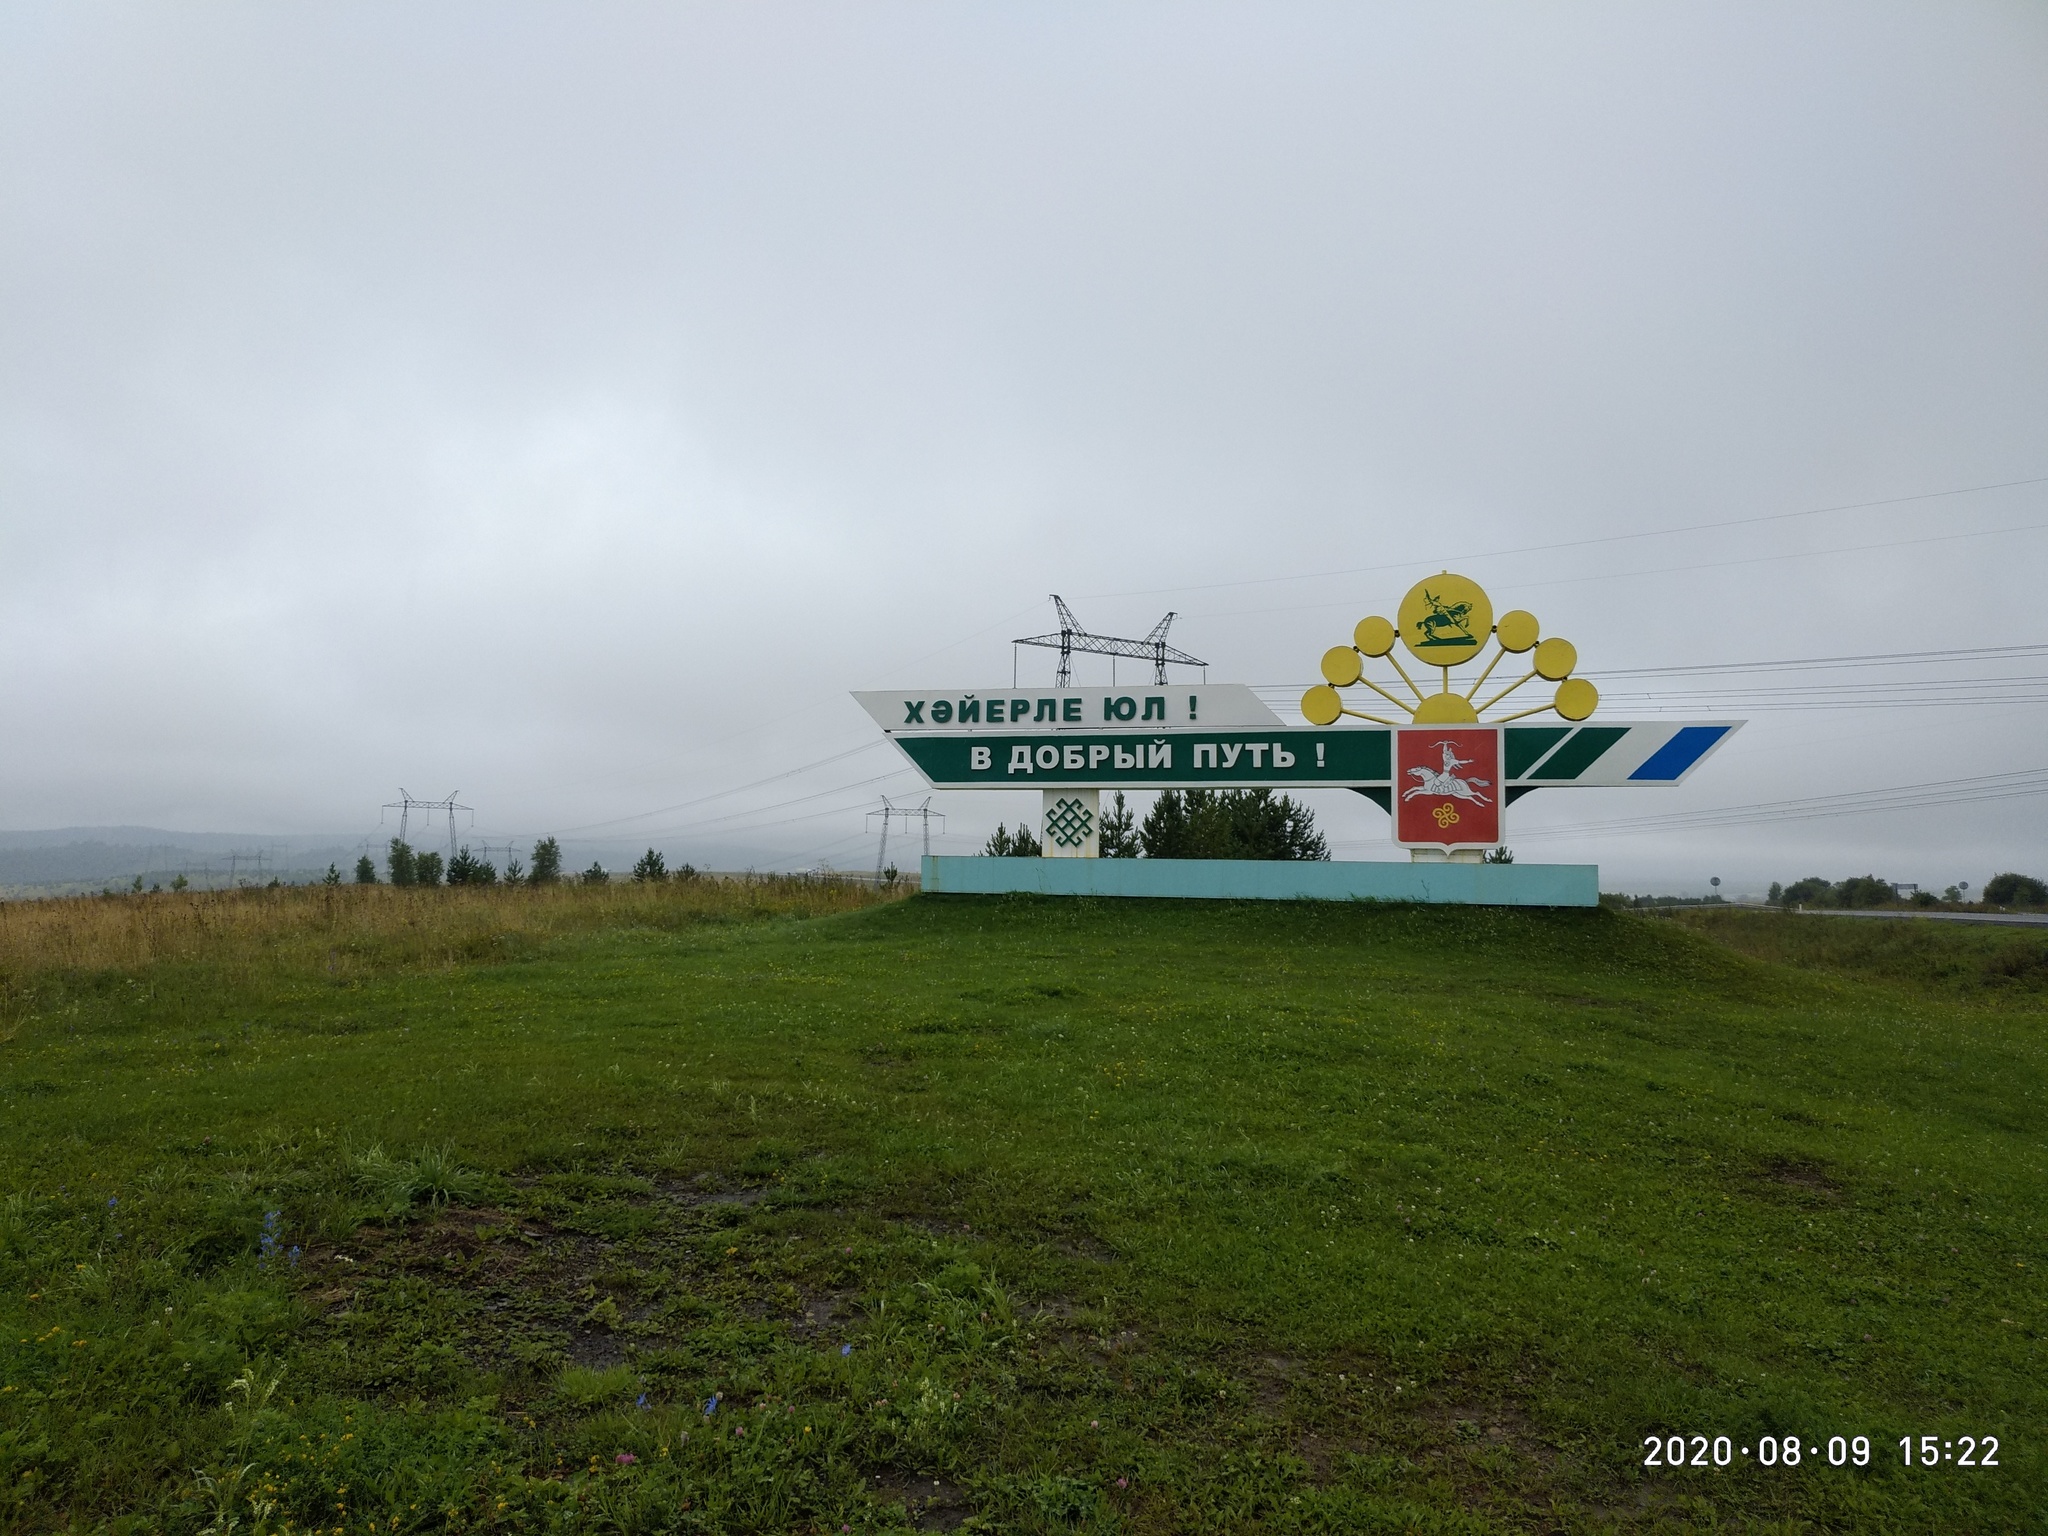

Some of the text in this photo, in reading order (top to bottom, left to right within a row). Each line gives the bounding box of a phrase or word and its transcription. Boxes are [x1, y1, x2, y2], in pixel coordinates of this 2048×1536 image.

[903, 694, 1083, 724] ХӘЙЕРЛЕ
[1103, 696, 1166, 721] ЮЛ
[970, 746, 992, 771] В
[1008, 739, 1173, 775] ДОБРЫЙ
[1193, 743, 1297, 769] ПУТЬ
